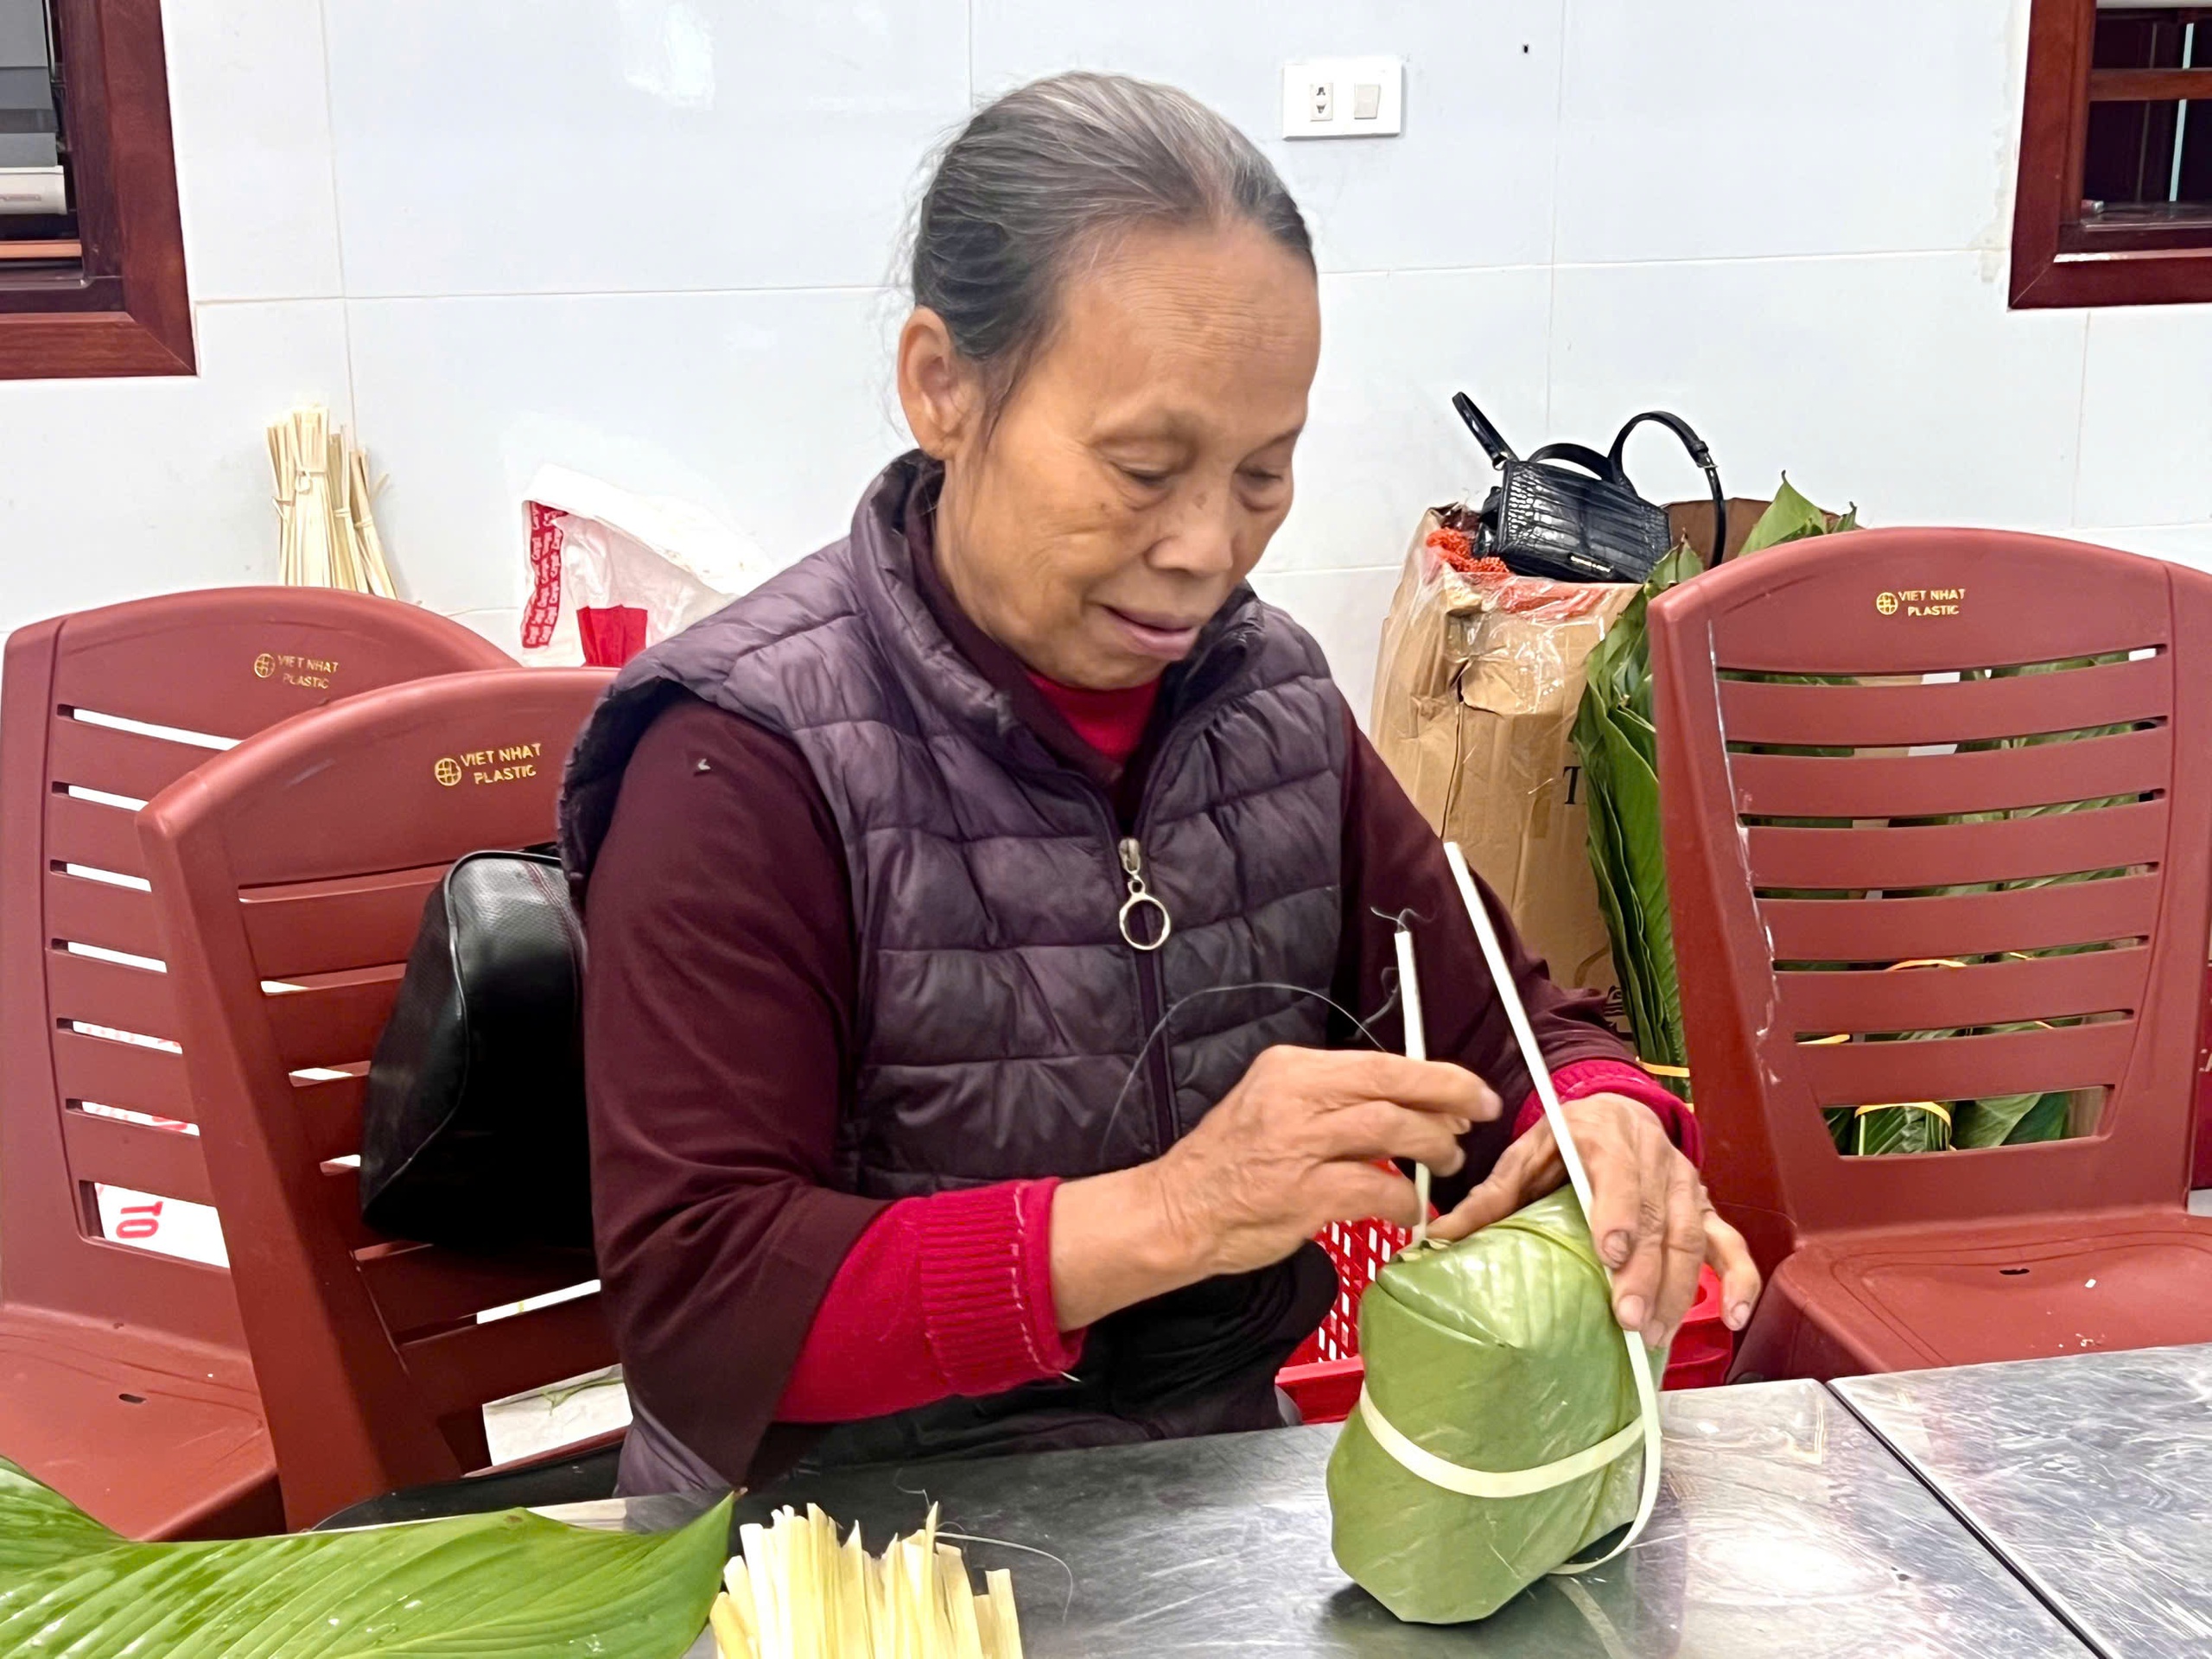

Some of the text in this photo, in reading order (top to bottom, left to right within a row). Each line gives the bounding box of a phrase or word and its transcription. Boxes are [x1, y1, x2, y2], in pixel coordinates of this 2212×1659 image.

[1897, 588, 1966, 601] VIET NHAT
[1907, 605, 1960, 616] PLASTIC
[277, 655, 339, 673] VIET NHAT
[282, 673, 329, 689] PLASTIC
[460, 742, 541, 767] VIET NHAT
[474, 765, 537, 785] PLASTIC
[1562, 766, 1584, 805] T
